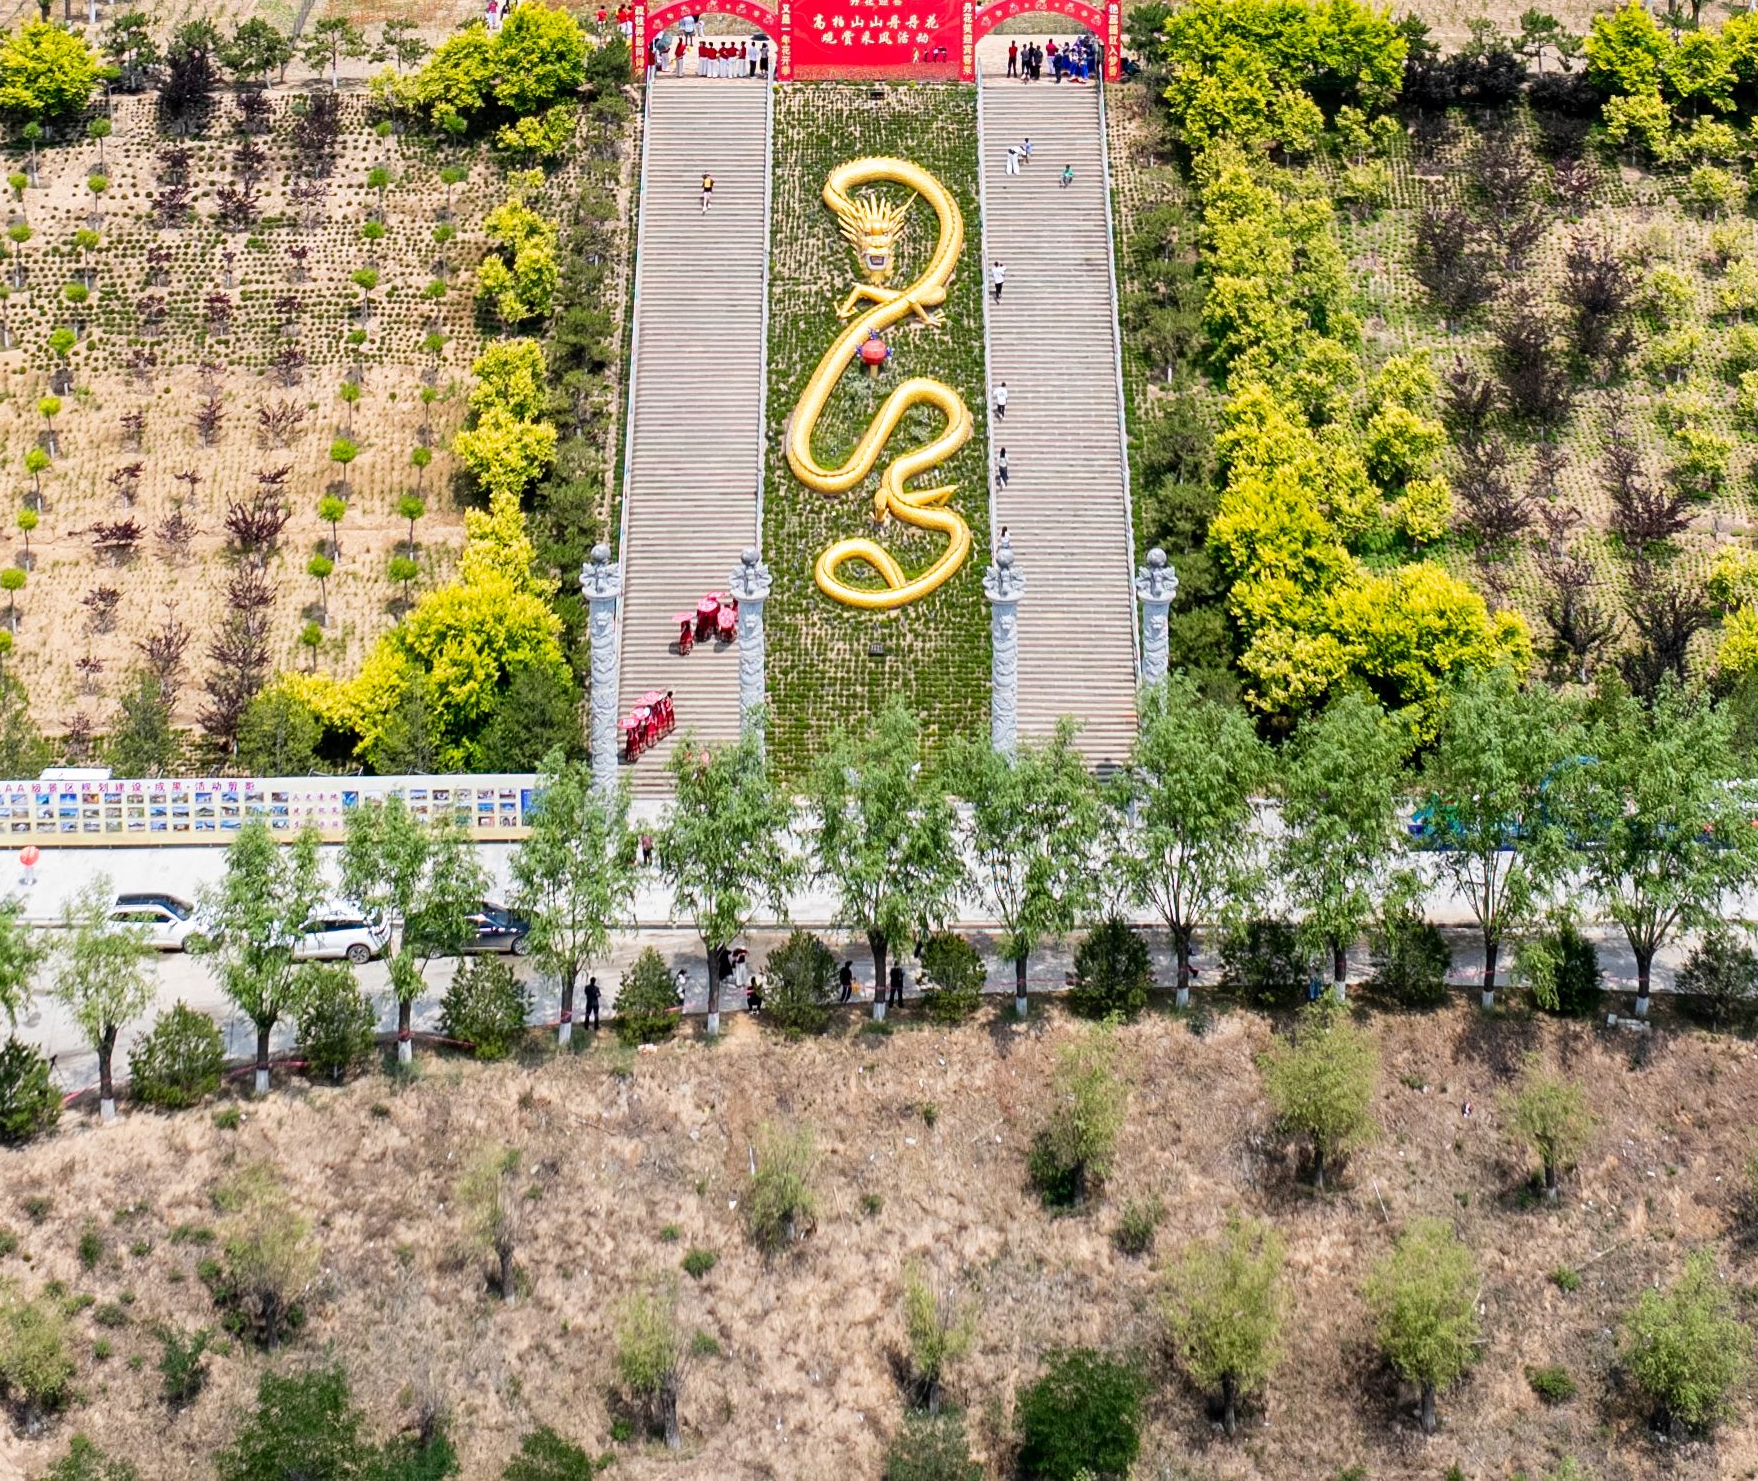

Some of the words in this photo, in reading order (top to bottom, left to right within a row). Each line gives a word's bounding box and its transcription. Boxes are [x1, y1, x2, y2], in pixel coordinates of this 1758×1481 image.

[813, 13, 940, 30] 高柏山山丹丹花
[820, 30, 930, 46] 观赏采风活动
[962, 1, 973, 75] 丹花笑迎宾客来
